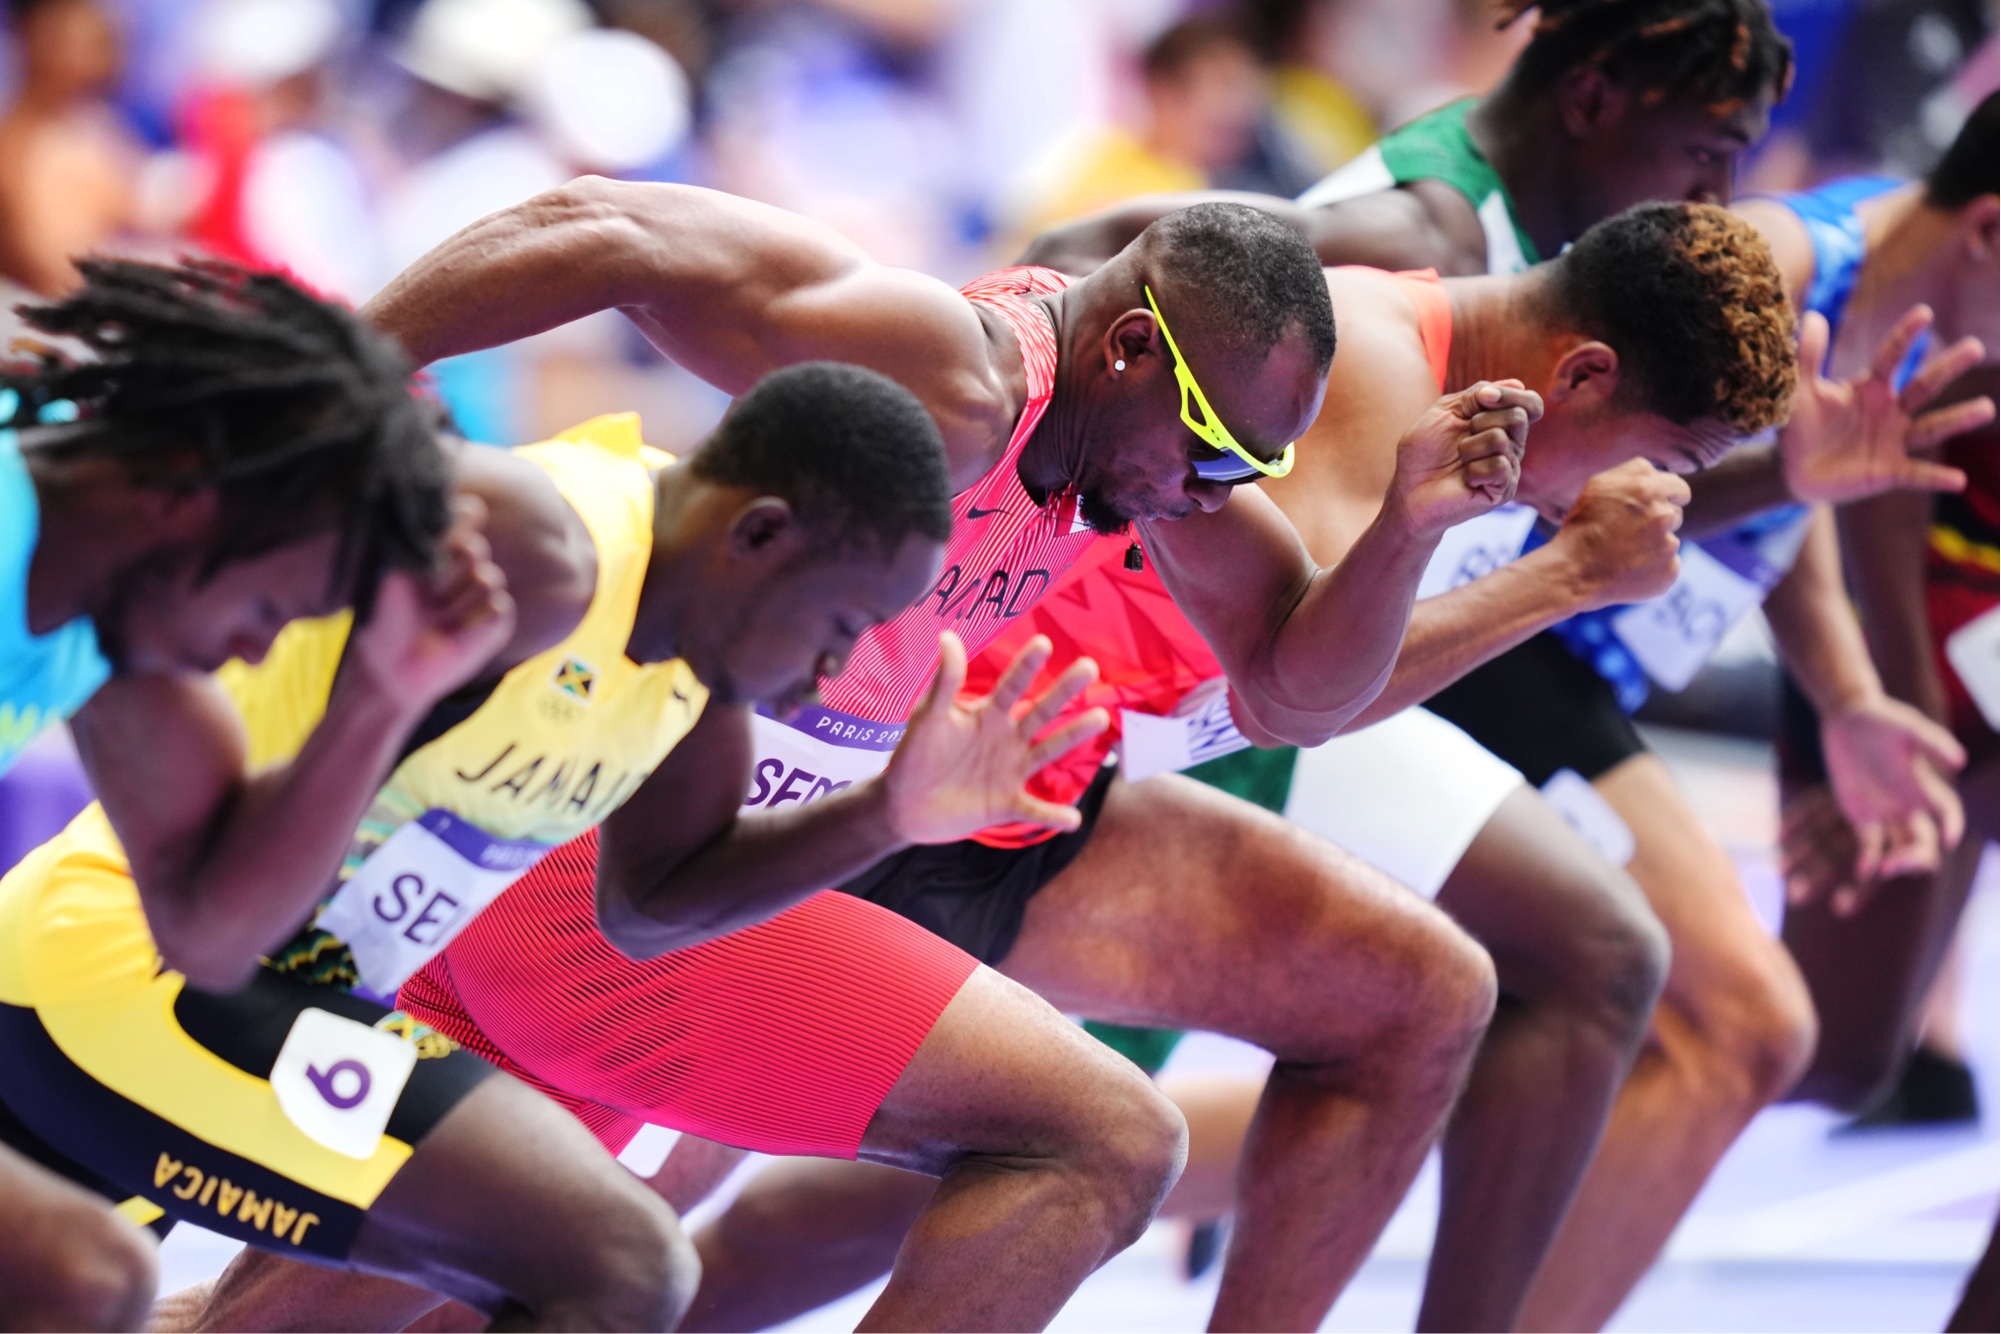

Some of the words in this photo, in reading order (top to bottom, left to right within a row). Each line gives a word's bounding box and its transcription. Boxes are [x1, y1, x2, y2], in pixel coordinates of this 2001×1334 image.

[875, 727, 908, 744] 202
[456, 741, 648, 818] JAMAI
[373, 873, 466, 947] SE
[153, 1150, 321, 1247] JAMAICA
